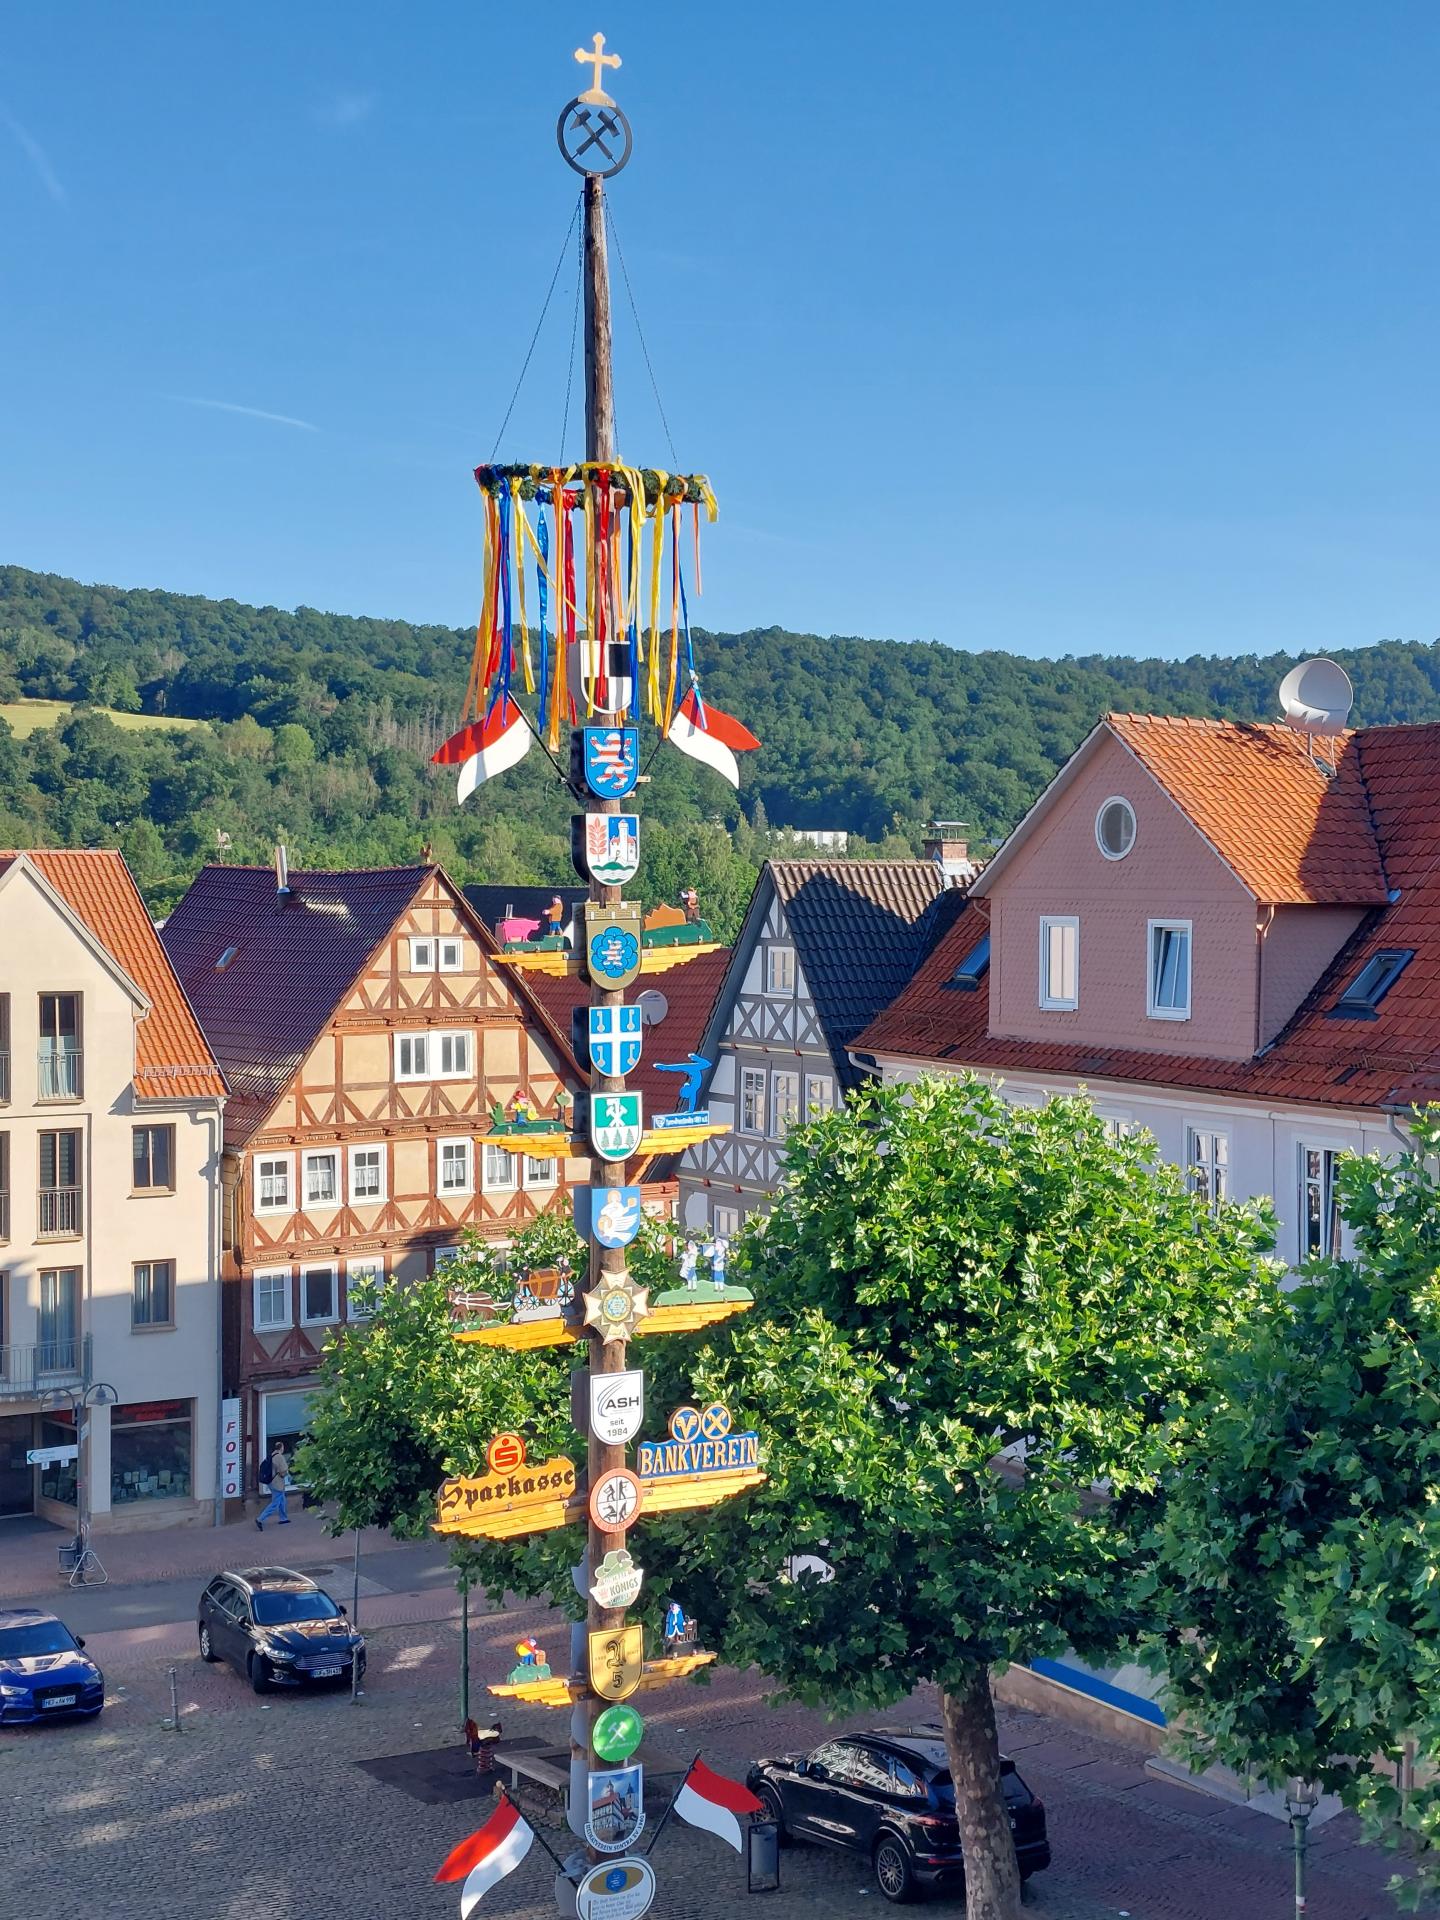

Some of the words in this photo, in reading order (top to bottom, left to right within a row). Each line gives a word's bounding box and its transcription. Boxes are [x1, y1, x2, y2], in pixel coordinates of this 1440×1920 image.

[605, 1396, 639, 1409] ASH
[607, 1428, 628, 1437] 1984
[610, 1418, 624, 1426] seit
[225, 1421, 237, 1494] FOTO
[640, 1437, 758, 1475] BANKVEREIN
[440, 1469, 574, 1511] Sparkasse
[609, 1576, 639, 1597] KÖNIGS
